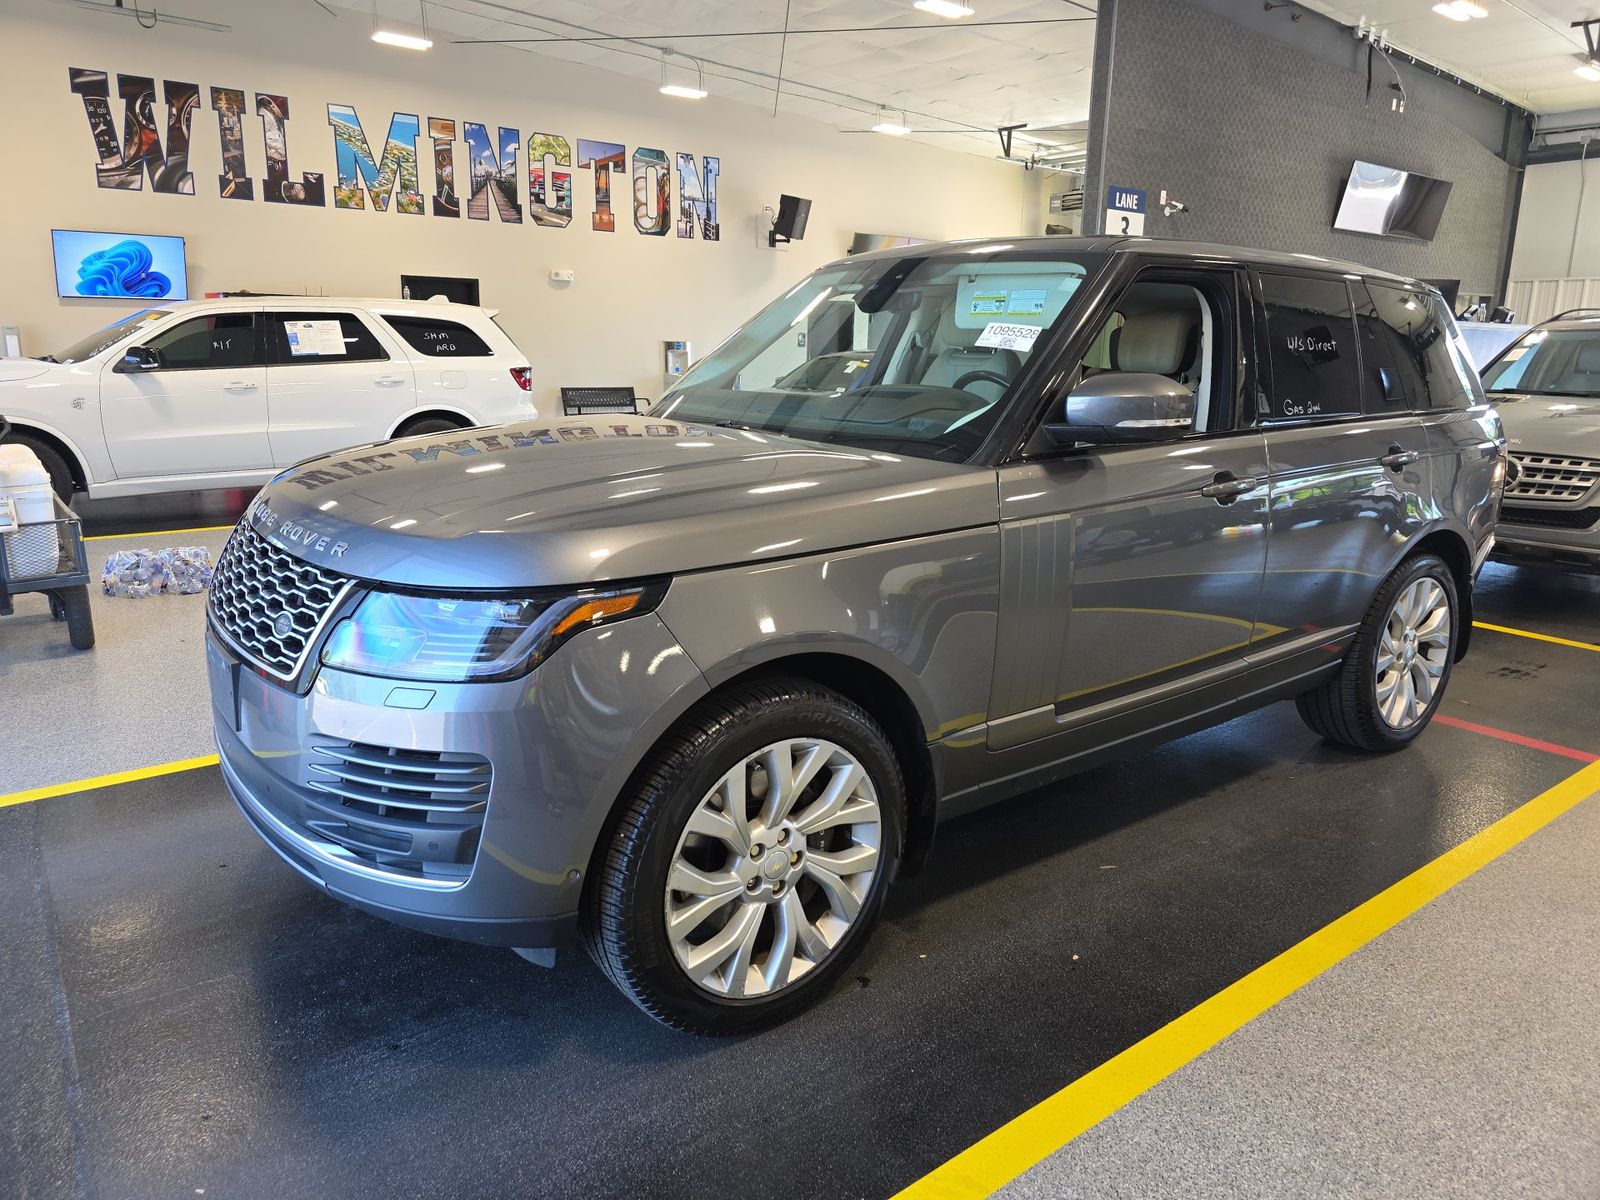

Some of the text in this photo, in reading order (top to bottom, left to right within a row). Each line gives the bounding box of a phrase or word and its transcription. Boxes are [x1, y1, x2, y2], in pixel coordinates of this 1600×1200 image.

[69, 67, 720, 241] WILMINGTON
[1115, 192, 1139, 209] LANE
[988, 325, 1040, 340] 1095528
[1307, 337, 1337, 351] Direct
[280, 520, 350, 558] ROVER
